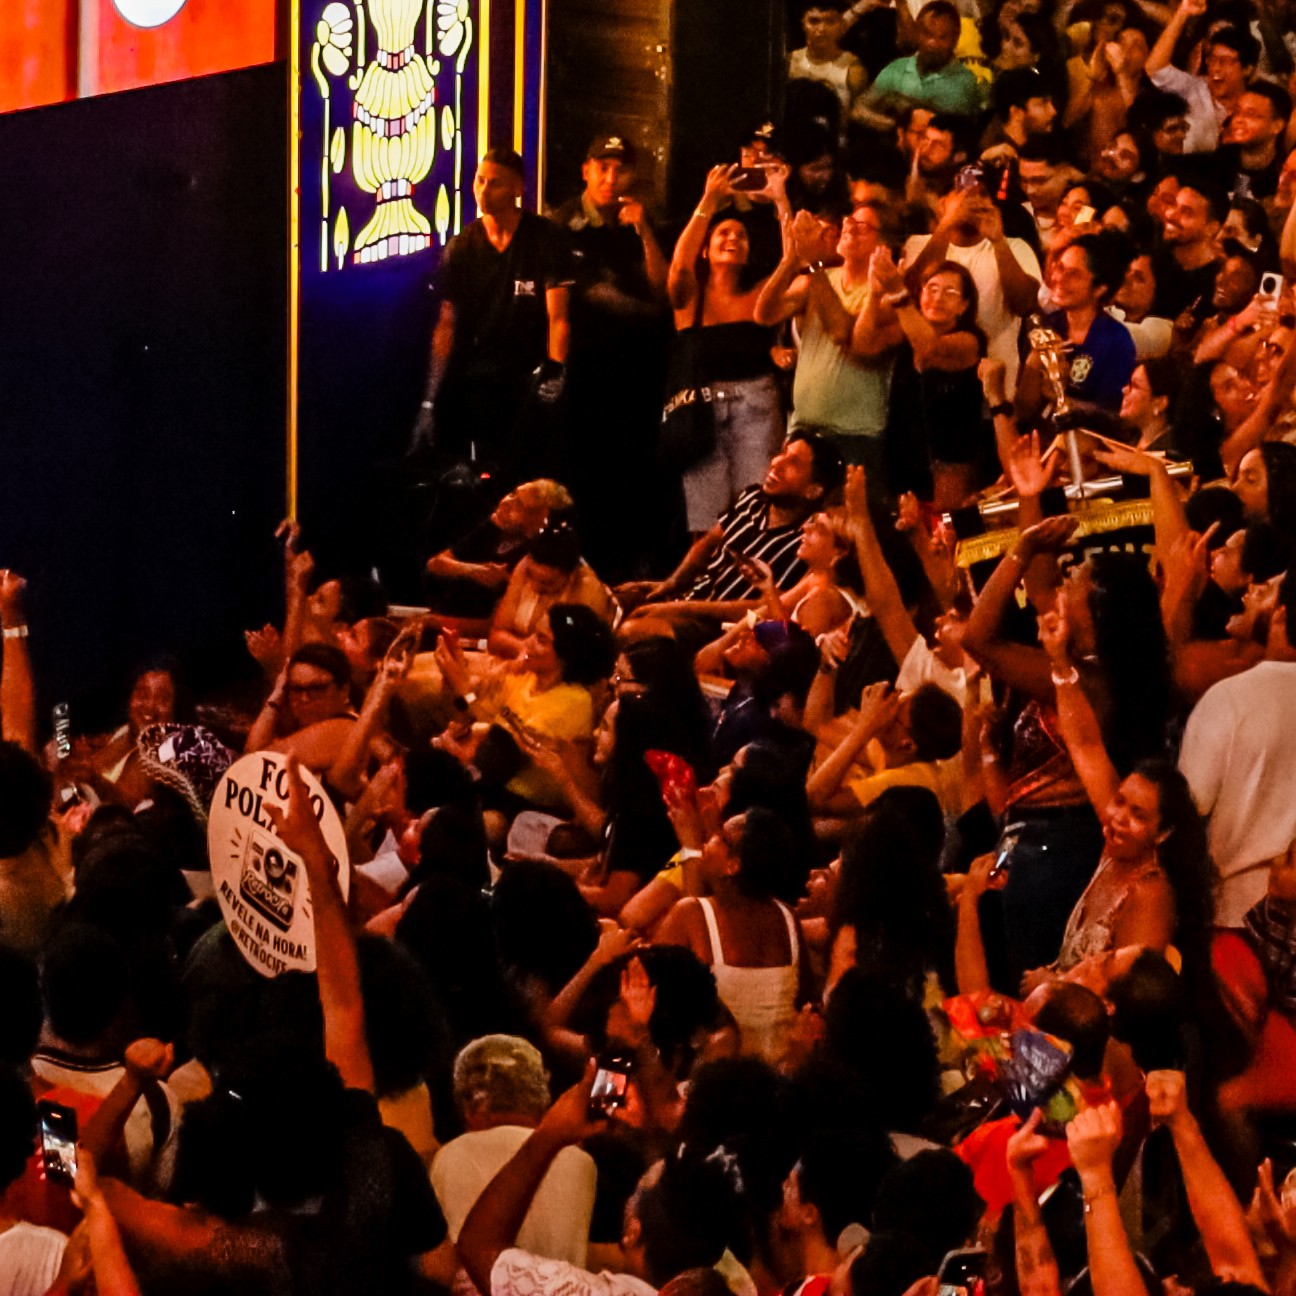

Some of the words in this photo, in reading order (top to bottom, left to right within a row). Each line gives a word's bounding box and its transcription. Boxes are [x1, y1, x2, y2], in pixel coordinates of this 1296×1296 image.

[259, 757, 324, 823] FOO
[220, 880, 255, 931] REVELE
[255, 921, 270, 945] NA
[272, 934, 307, 961] HORA!
